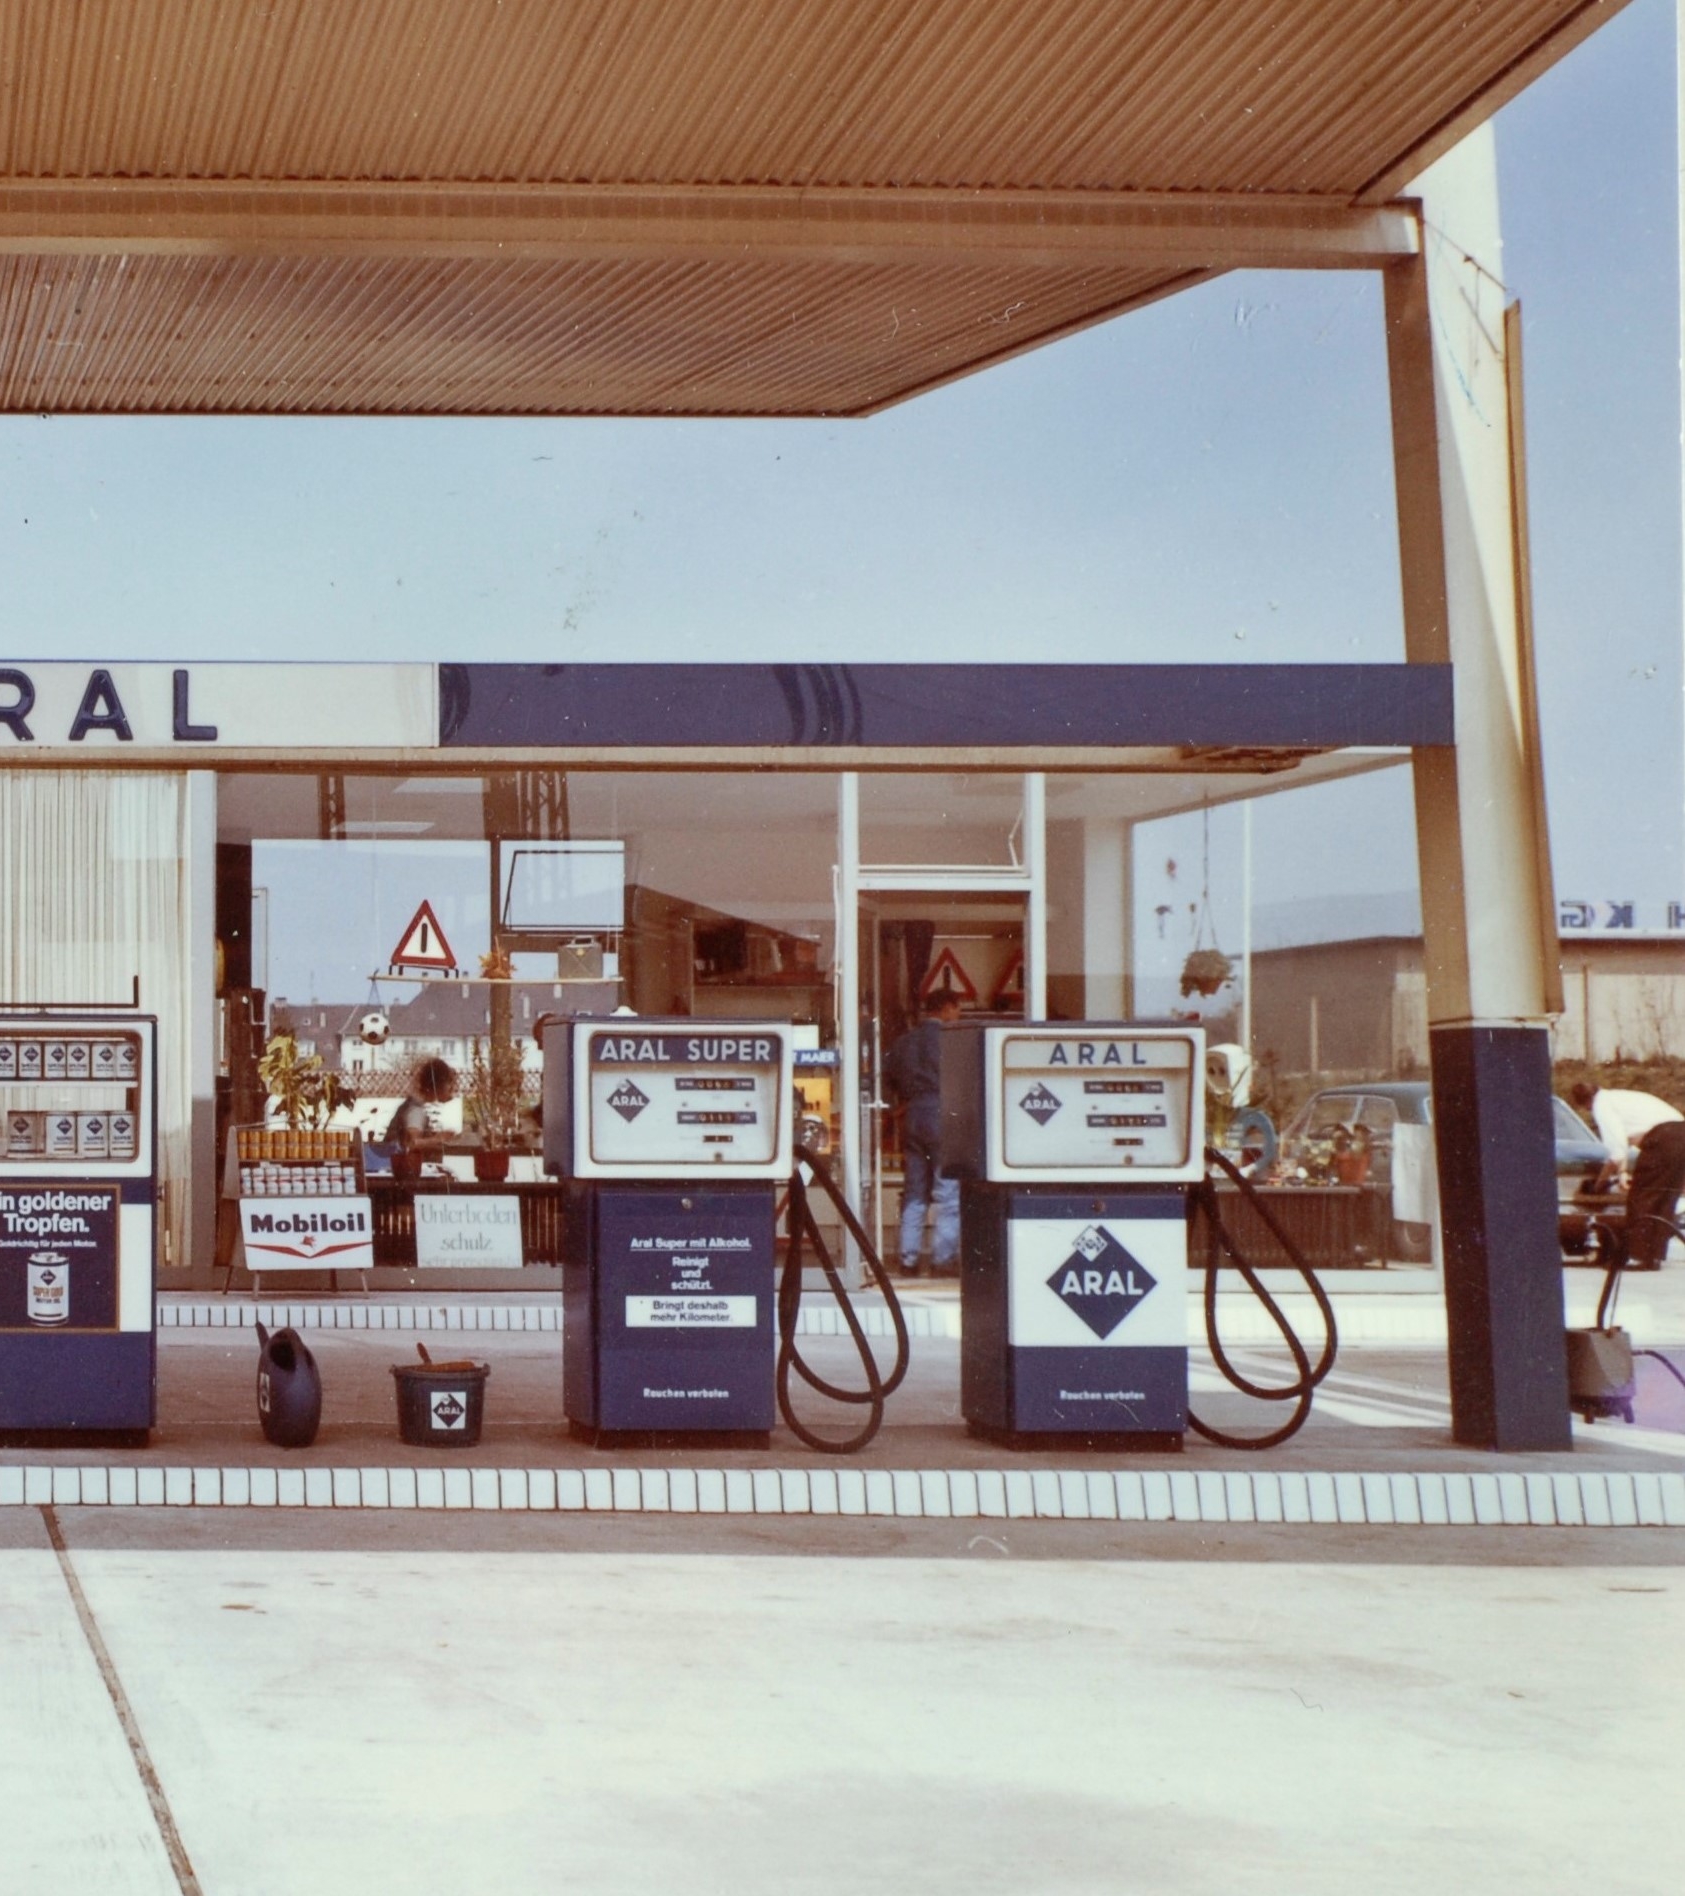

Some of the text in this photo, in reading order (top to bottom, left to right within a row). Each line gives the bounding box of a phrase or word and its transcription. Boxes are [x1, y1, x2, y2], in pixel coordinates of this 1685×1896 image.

[599, 1039, 671, 1061] ARAL
[687, 1039, 771, 1061] SUPER
[1049, 1043, 1147, 1065] ARAL
[611, 1095, 645, 1106] ARAL
[1024, 1099, 1058, 1110] ARAL
[18, 1191, 112, 1215] goldener
[3, 1213, 90, 1237] Tropfen.
[250, 1212, 365, 1233] Mobiloil
[39, 1239, 51, 1248] für
[51, 1239, 72, 1249] jeden
[630, 1237, 752, 1250] Aral Super mit Alkohol.
[672, 1256, 709, 1268] Reinigt
[681, 1268, 702, 1278] und
[671, 1280, 713, 1290] schützt.
[1061, 1270, 1144, 1295] ARAL
[652, 1301, 728, 1312] Bringt deshalb
[650, 1312, 733, 1322] mehr Kilometer.
[643, 1388, 729, 1398] Rauchen verboten
[1060, 1390, 1145, 1400] Rauchen verboten
[436, 1406, 461, 1415] ARAL
